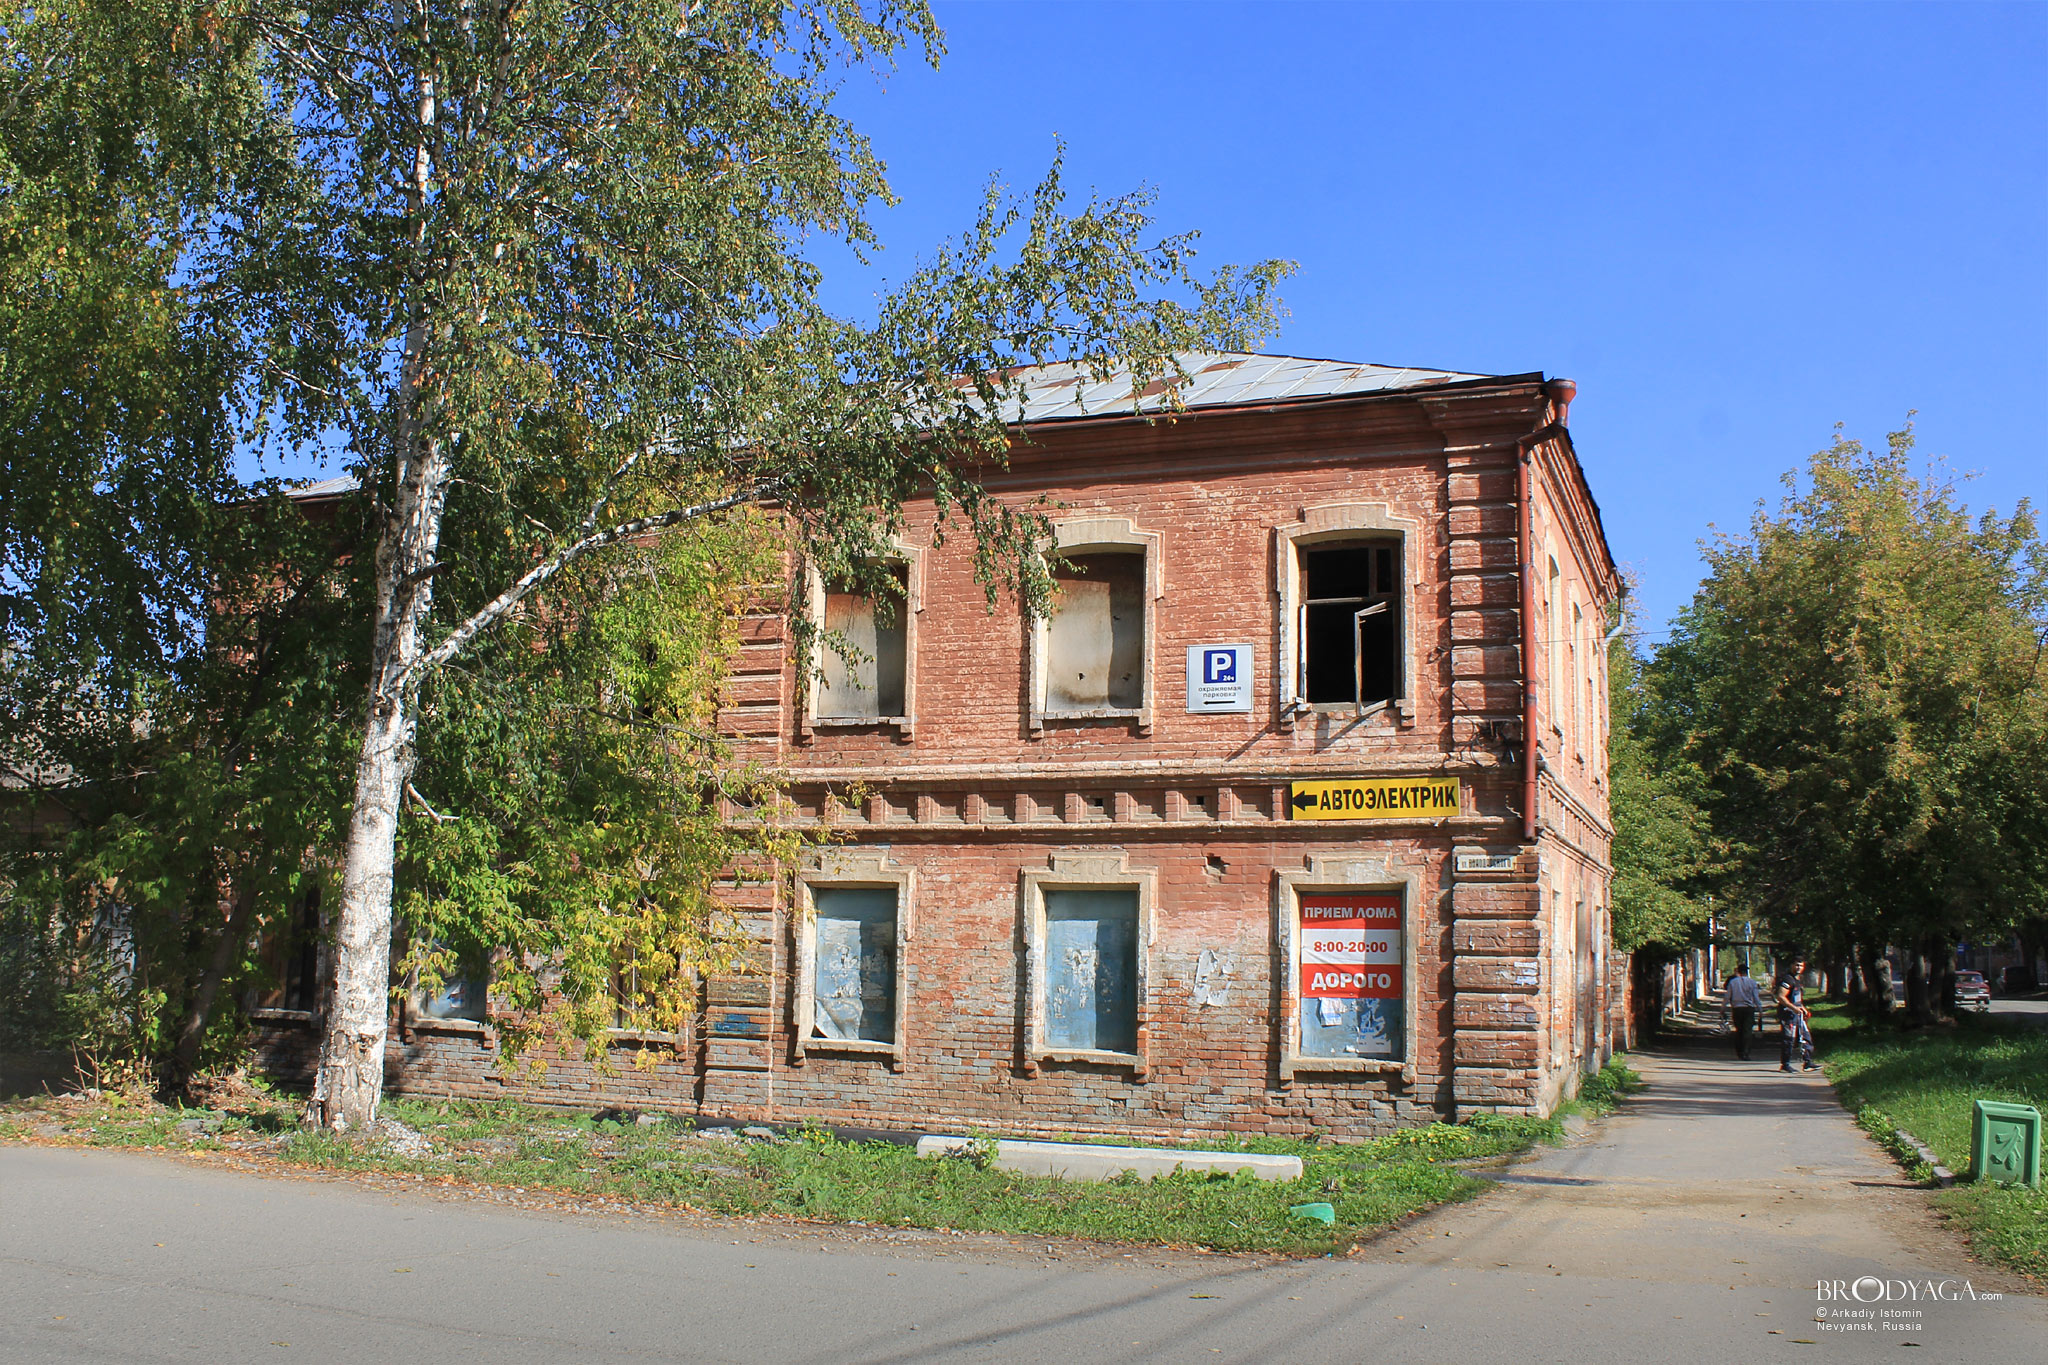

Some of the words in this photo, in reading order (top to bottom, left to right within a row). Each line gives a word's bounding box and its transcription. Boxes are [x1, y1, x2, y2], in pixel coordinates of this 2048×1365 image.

[1211, 653, 1232, 680] P
[1320, 786, 1457, 810] АВТОЭЛЕКТРИК
[1304, 907, 1353, 919] ПРИЕМ
[1356, 907, 1397, 919] ЛОМА
[1314, 941, 1388, 953] 8:00-20:00
[1311, 972, 1392, 991] ДОРОГО
